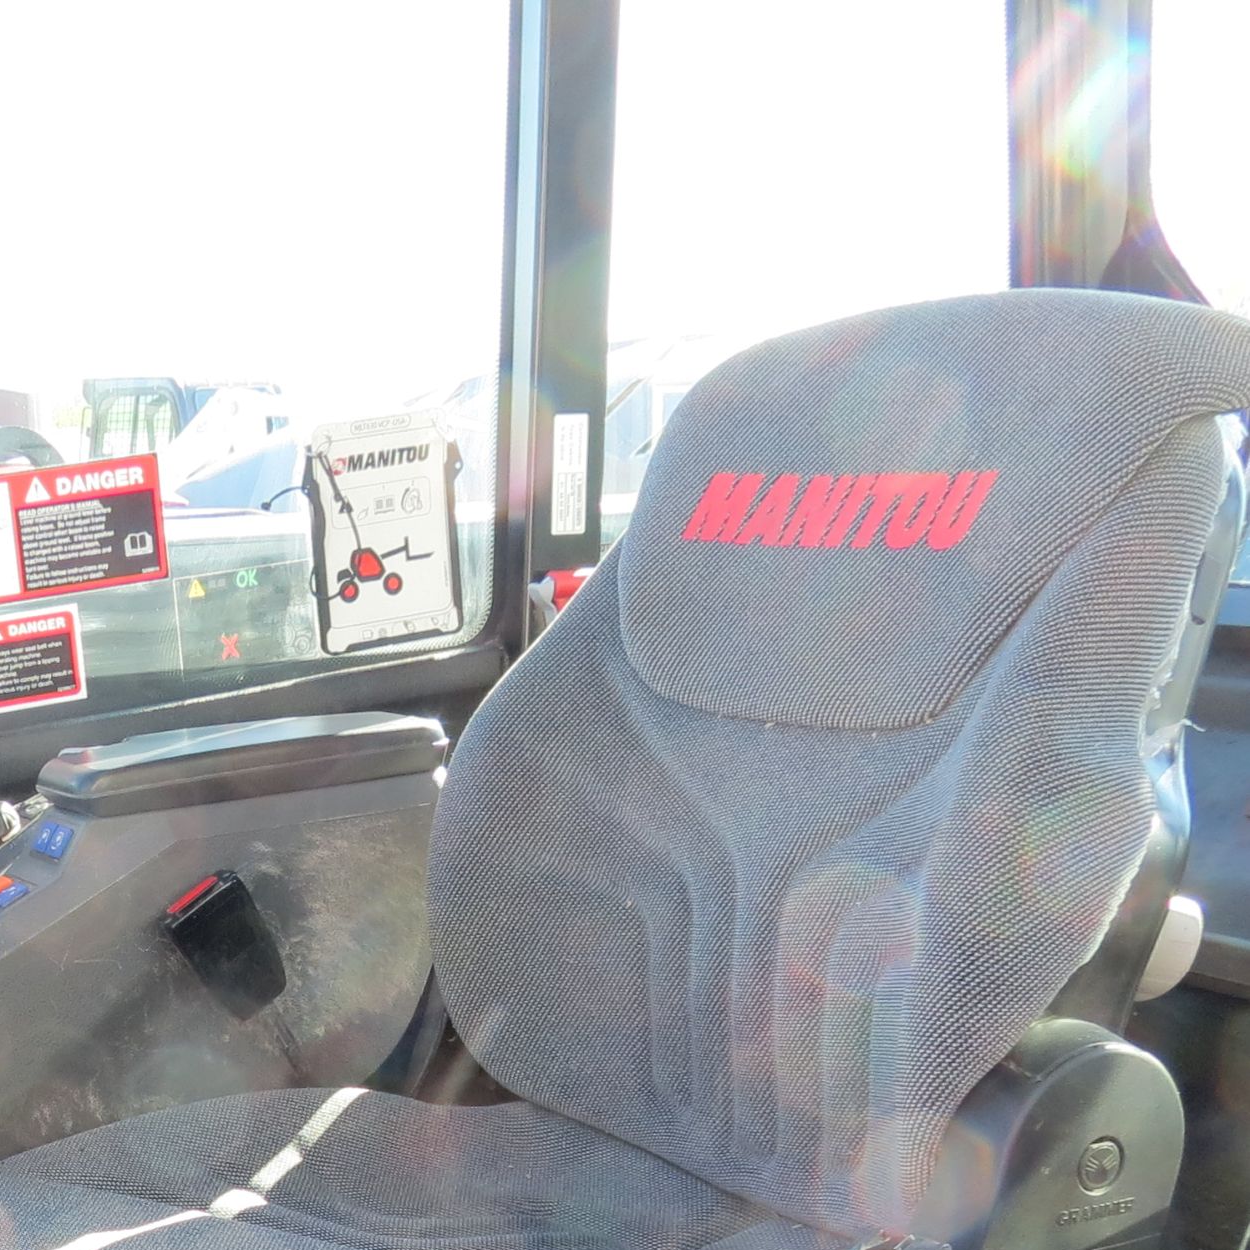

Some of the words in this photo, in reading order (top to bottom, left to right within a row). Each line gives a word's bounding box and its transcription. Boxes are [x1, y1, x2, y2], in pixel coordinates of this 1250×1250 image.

[347, 444, 430, 473] MANITOU
[55, 467, 144, 496] DANGER
[681, 470, 1000, 551] MANITOU
[236, 569, 258, 588] OK
[7, 616, 66, 637] DANGER
[1055, 1197, 1135, 1226] GRAMMER
